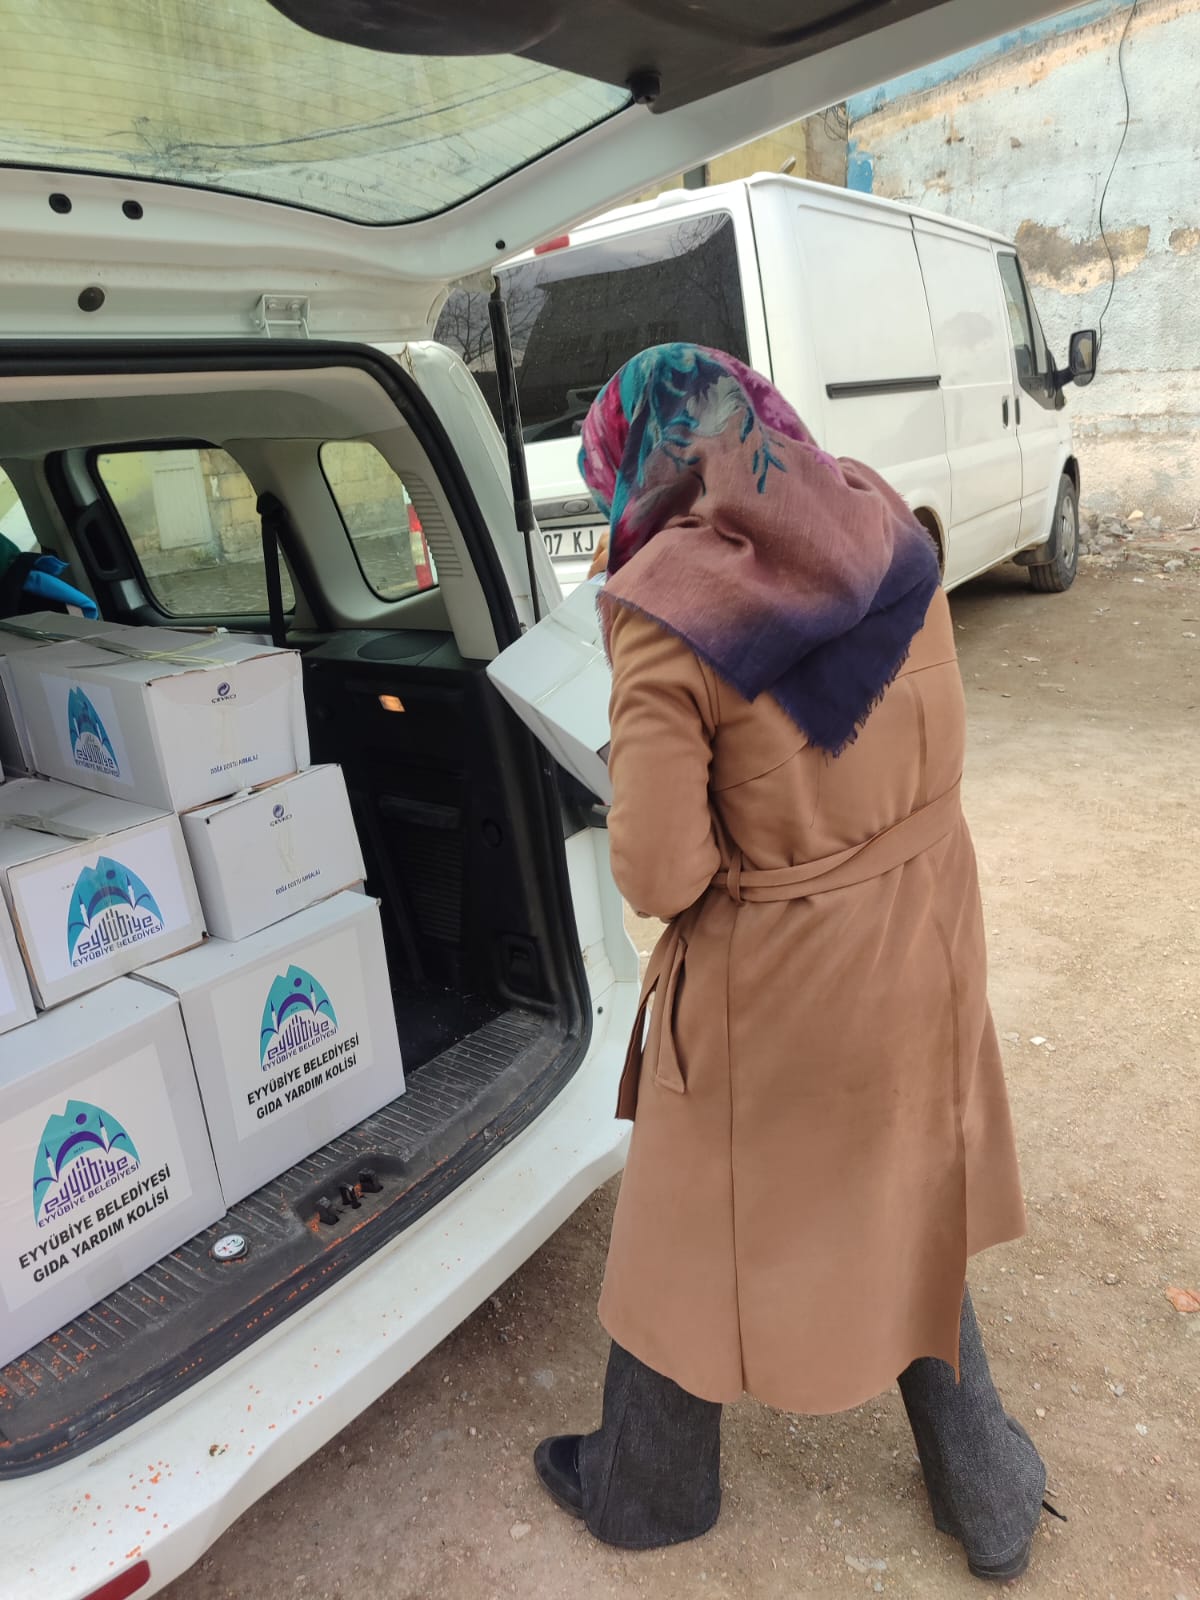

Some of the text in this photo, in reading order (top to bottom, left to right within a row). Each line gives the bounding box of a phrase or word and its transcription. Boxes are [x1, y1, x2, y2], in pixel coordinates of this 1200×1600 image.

[573, 530, 594, 553] KJ
[73, 923, 163, 967] EYYÜBİYE BELEDİYESİ
[77, 908, 154, 956] eyyübiye
[262, 1027, 337, 1072] EYYÜBİYE BELEDİYESİ
[267, 1014, 330, 1060] eyyübiye
[247, 1032, 359, 1105] EYYÜBİYE BELEDİYESİ
[256, 1052, 357, 1120] GIDA YARDIM KOLİSİ
[38, 1161, 139, 1228] EYYÜBİYE BELEDİYESİ
[44, 1156, 129, 1214] eyyübiye
[18, 1163, 171, 1269] EYYÜBİYE BELEDİYESİ
[33, 1185, 169, 1283] GIDA YARDIM KOLİSİ
